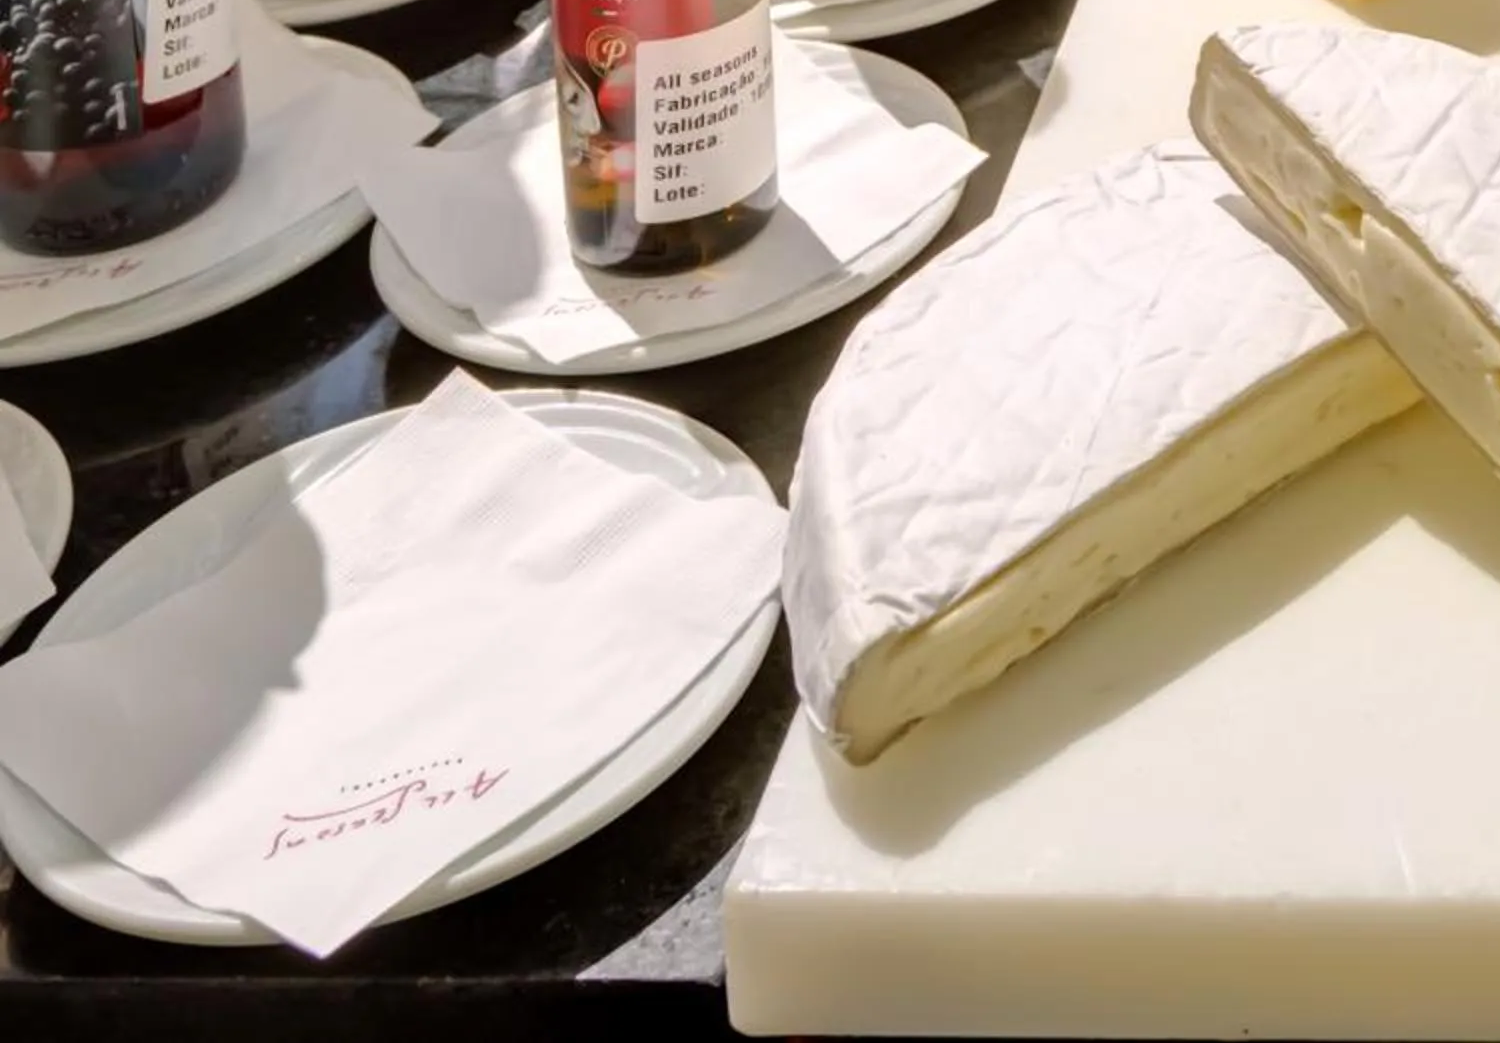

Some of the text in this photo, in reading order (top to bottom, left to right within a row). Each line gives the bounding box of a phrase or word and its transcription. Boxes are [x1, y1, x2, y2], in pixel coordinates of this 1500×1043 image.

[653, 45, 758, 91] All seasons
[653, 163, 689, 182] Sif:
[653, 183, 706, 204] Lote:
